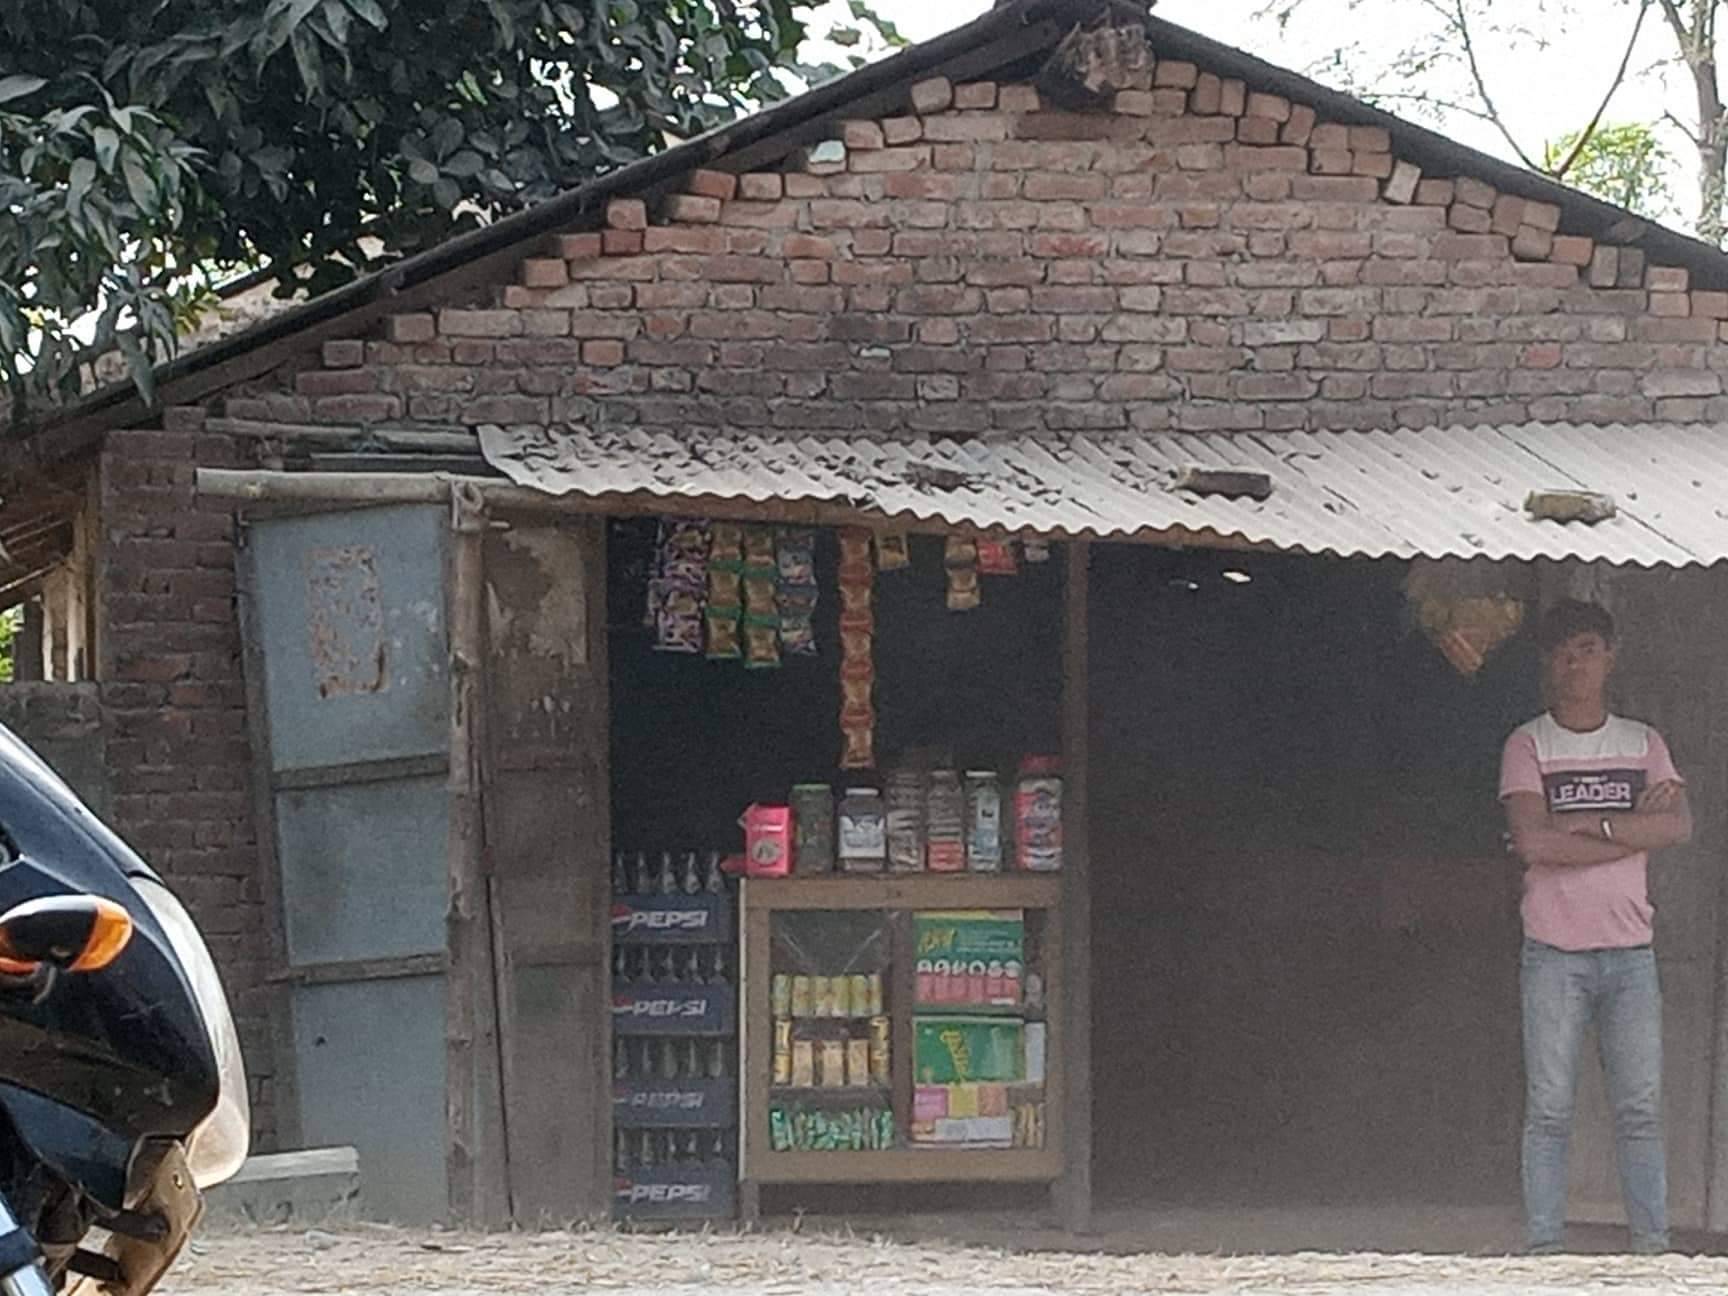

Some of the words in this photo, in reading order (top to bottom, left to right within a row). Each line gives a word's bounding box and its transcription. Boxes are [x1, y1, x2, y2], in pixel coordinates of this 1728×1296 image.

[1551, 782, 1631, 803] LEADER
[627, 911, 709, 934] PEPSI
[630, 1184, 712, 1204] PEPSI
